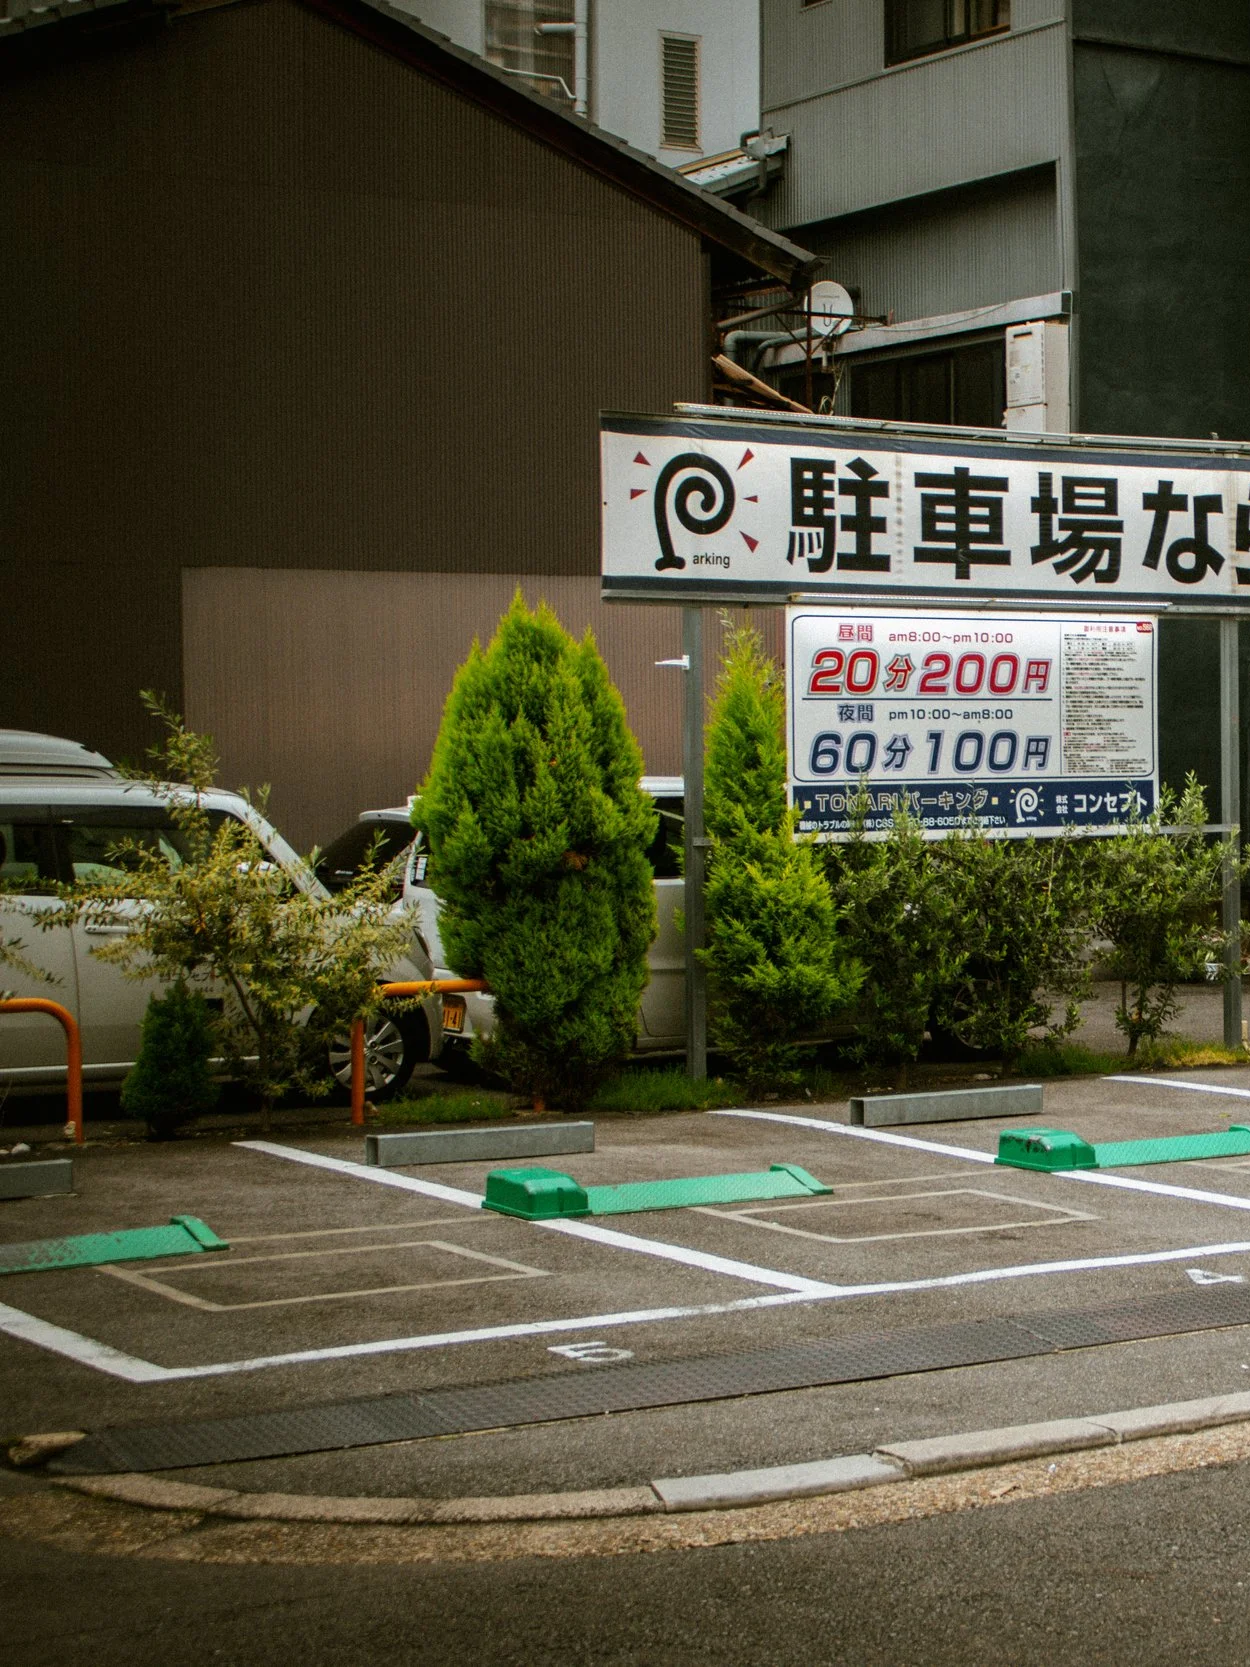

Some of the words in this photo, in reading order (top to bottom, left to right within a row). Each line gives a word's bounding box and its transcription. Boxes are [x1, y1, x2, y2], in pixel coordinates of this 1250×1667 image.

[693, 553, 730, 568] arking
[838, 624, 874, 643] 昼間
[838, 704, 874, 723] 夜間
[547, 1341, 635, 1362] 5
